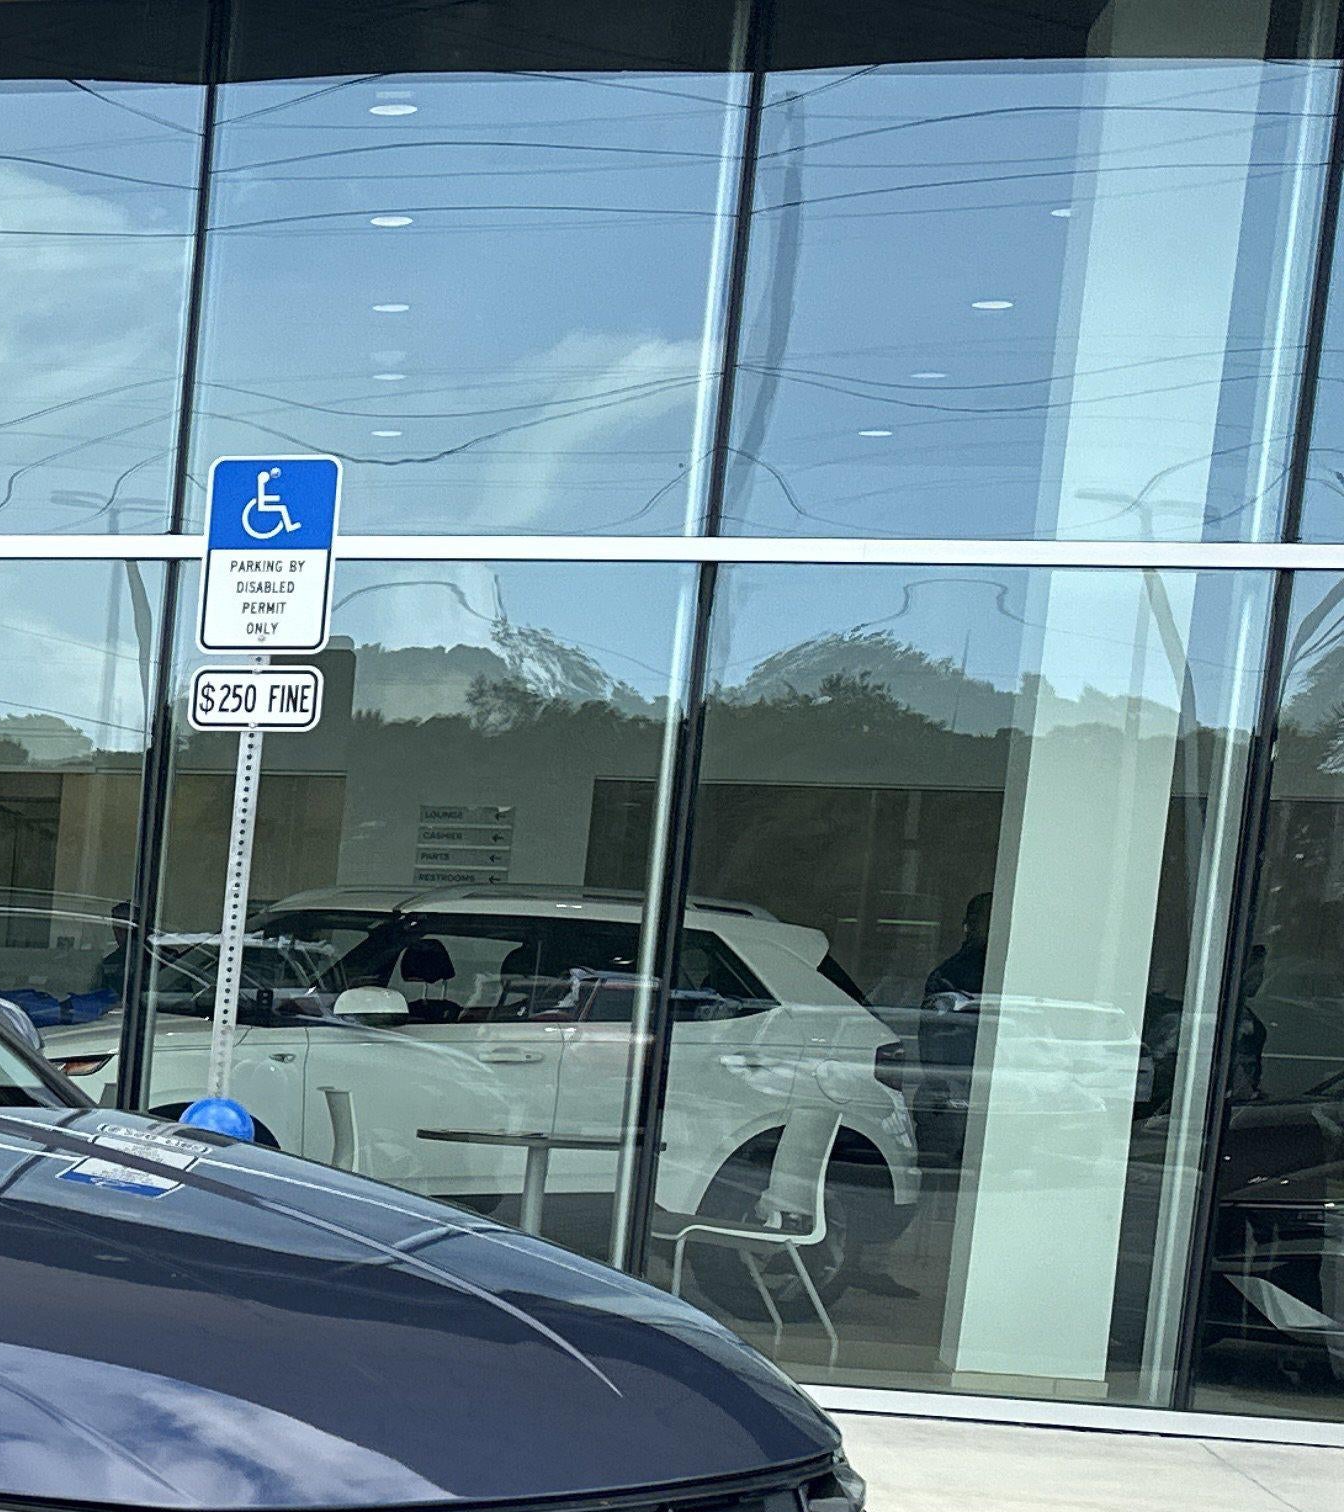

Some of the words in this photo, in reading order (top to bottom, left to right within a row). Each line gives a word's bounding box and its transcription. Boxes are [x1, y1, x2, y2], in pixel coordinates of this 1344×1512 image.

[230, 560, 283, 573] PARKING
[289, 560, 306, 573] BY
[236, 581, 295, 594] DISABLED
[242, 602, 287, 614] PERMIT
[246, 622, 279, 635] ONLY
[199, 682, 257, 715] $250
[268, 684, 311, 713] FINE
